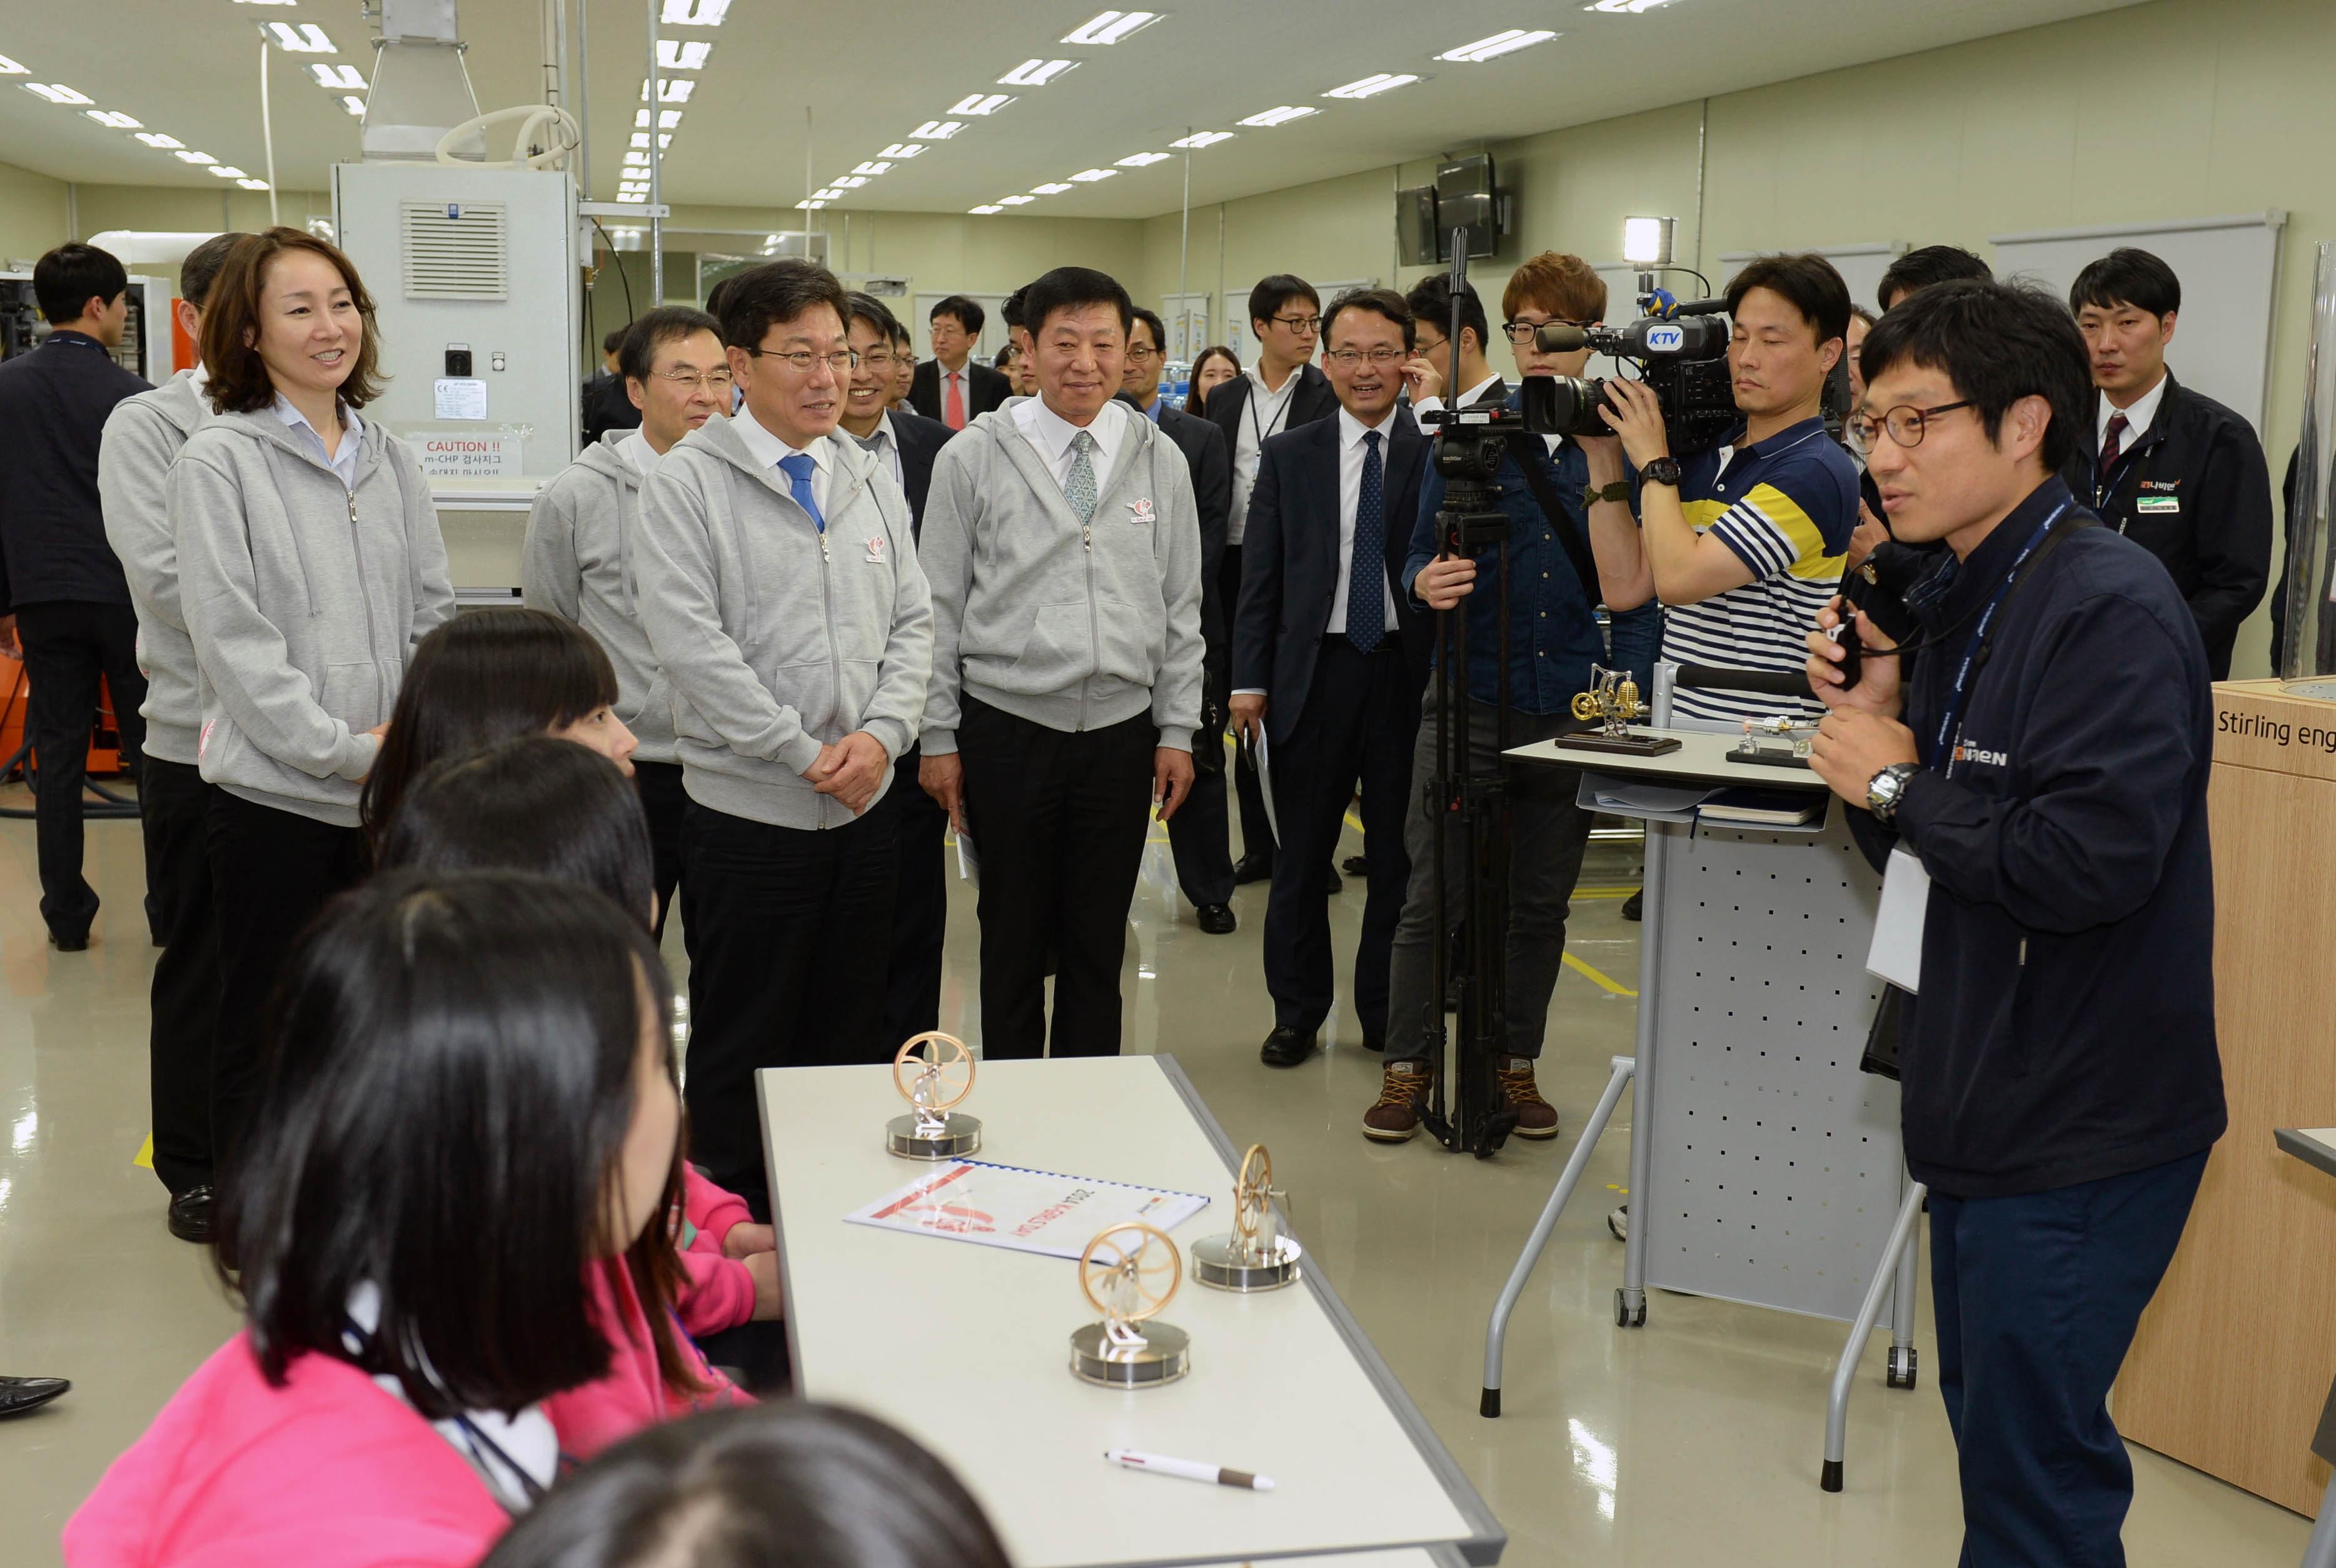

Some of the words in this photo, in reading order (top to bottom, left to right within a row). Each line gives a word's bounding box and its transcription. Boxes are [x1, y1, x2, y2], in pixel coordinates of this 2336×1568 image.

[1649, 333, 1680, 344] KTV
[427, 441, 487, 451] CAUTION
[425, 455, 458, 463] m-CHP
[463, 455, 502, 465] 검사지그
[2218, 711, 2290, 746] Stirling
[2298, 726, 2336, 753] eng
